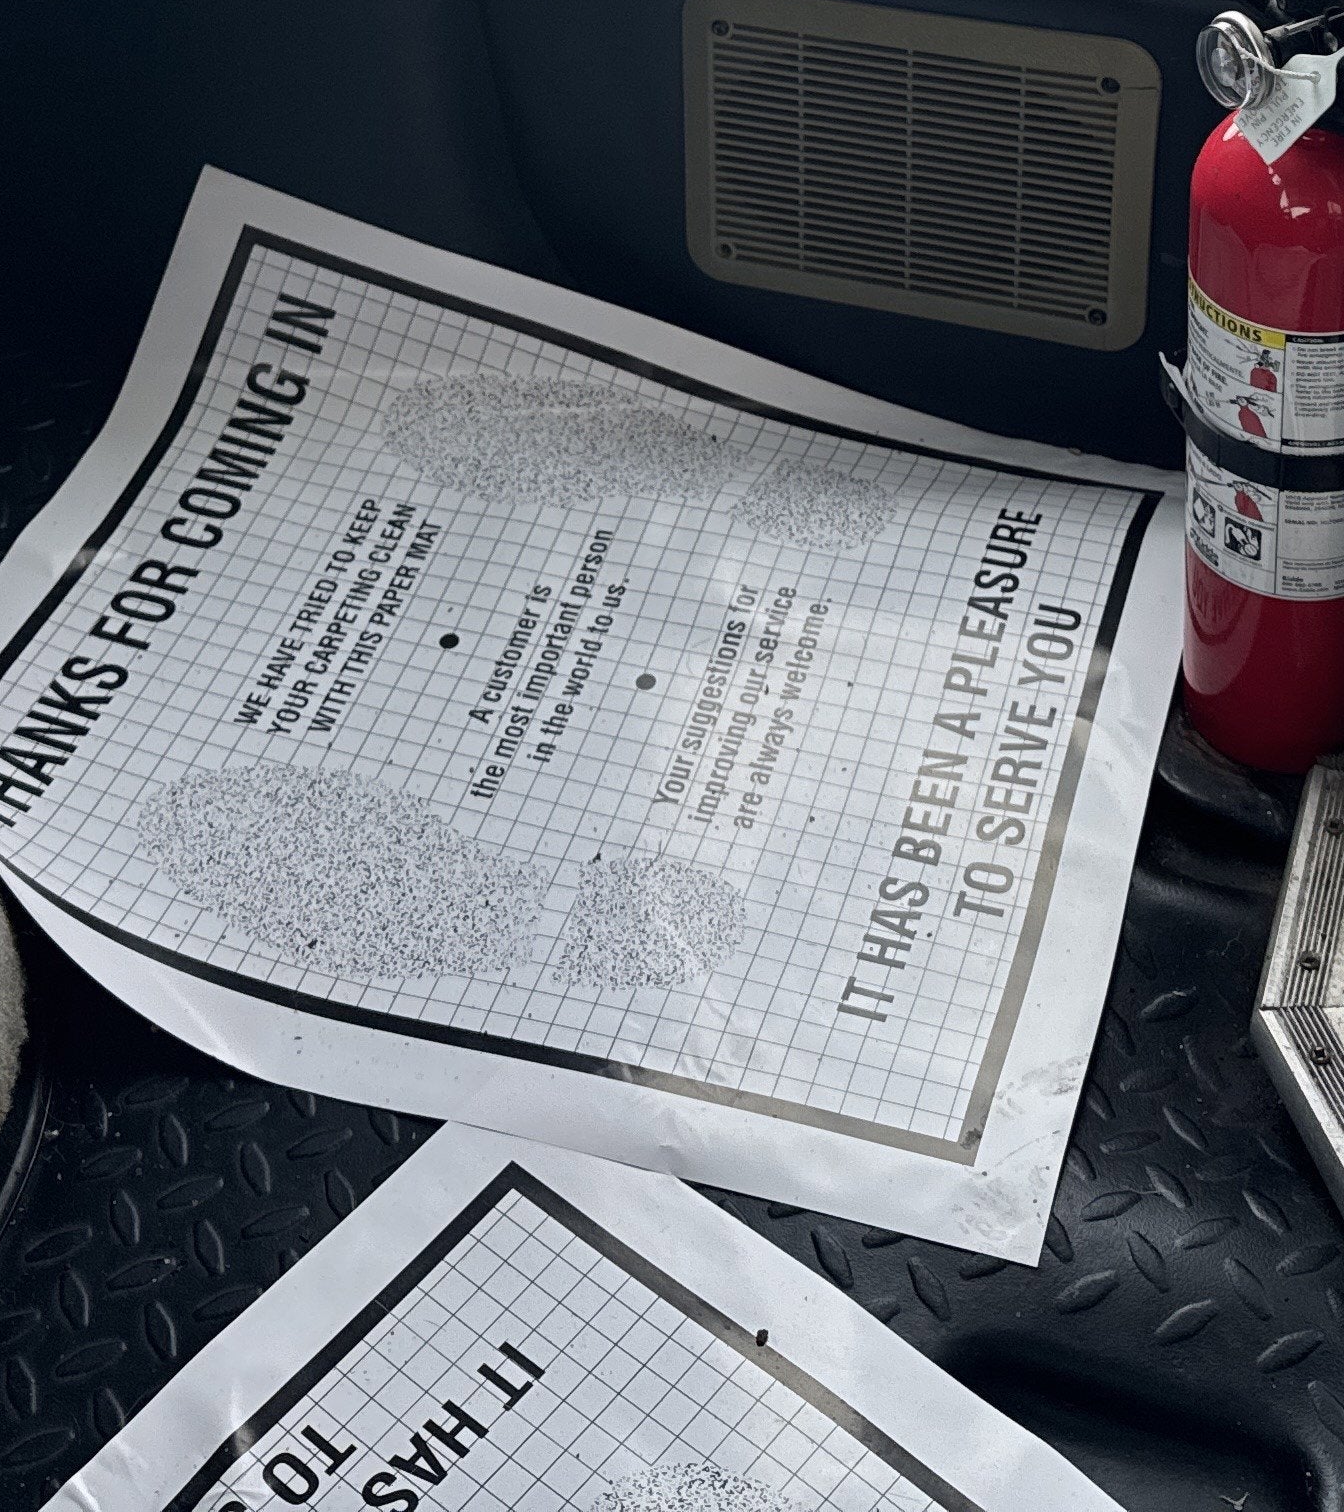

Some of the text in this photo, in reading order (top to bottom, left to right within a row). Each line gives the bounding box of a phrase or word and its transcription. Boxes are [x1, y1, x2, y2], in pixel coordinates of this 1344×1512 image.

[90, 558, 200, 650] FOR
[161, 362, 310, 549] COMING
[266, 292, 336, 354] IN
[234, 498, 381, 725] WE HAVE TRIED TO KEEP
[267, 503, 417, 734] YOUR CARPETING CLEAN
[308, 519, 442, 733] WITH THIS PAPER MAT
[468, 584, 553, 725] A customer is
[470, 529, 613, 799] the most important person
[527, 577, 630, 763] in the world to us.
[652, 584, 759, 805] Your suggestions for
[688, 586, 797, 824] improving our service
[733, 598, 832, 830] are always welcome.
[837, 506, 1043, 1023] IT HAS BEEN A PLEASURE
[954, 603, 1083, 918] TO SERVE YOU
[262, 1424, 357, 1506] TO
[361, 1341, 546, 1512] IT HAS
